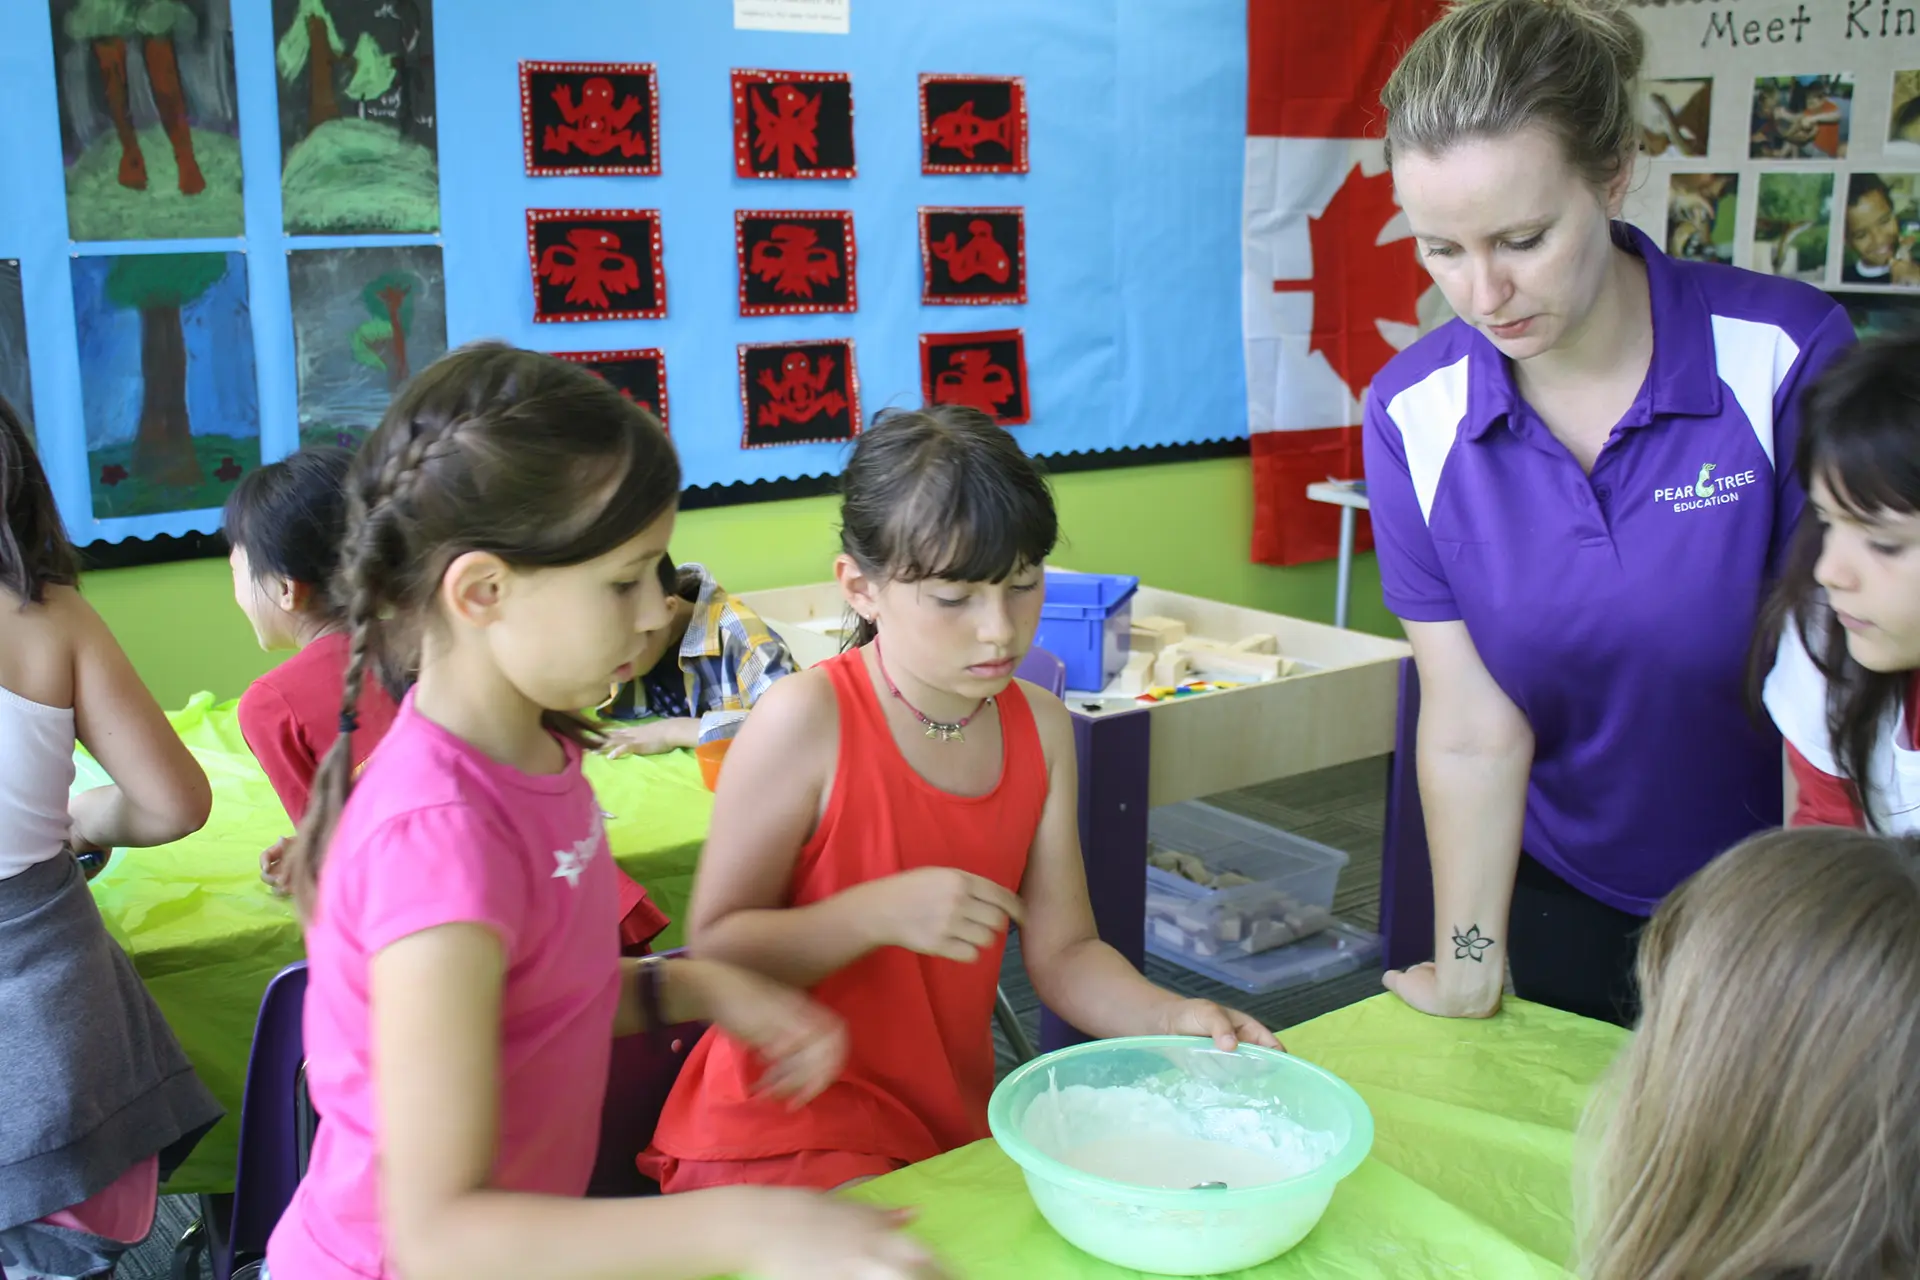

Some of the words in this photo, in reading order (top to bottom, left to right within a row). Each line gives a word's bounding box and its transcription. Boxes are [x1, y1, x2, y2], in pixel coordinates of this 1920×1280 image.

[1701, 4, 1811, 48] Meet
[1845, 0, 1915, 39] Kin
[1654, 485, 1694, 502] PEAR
[1714, 470, 1756, 491] TREE
[1673, 492, 1739, 513] EDUCATION
